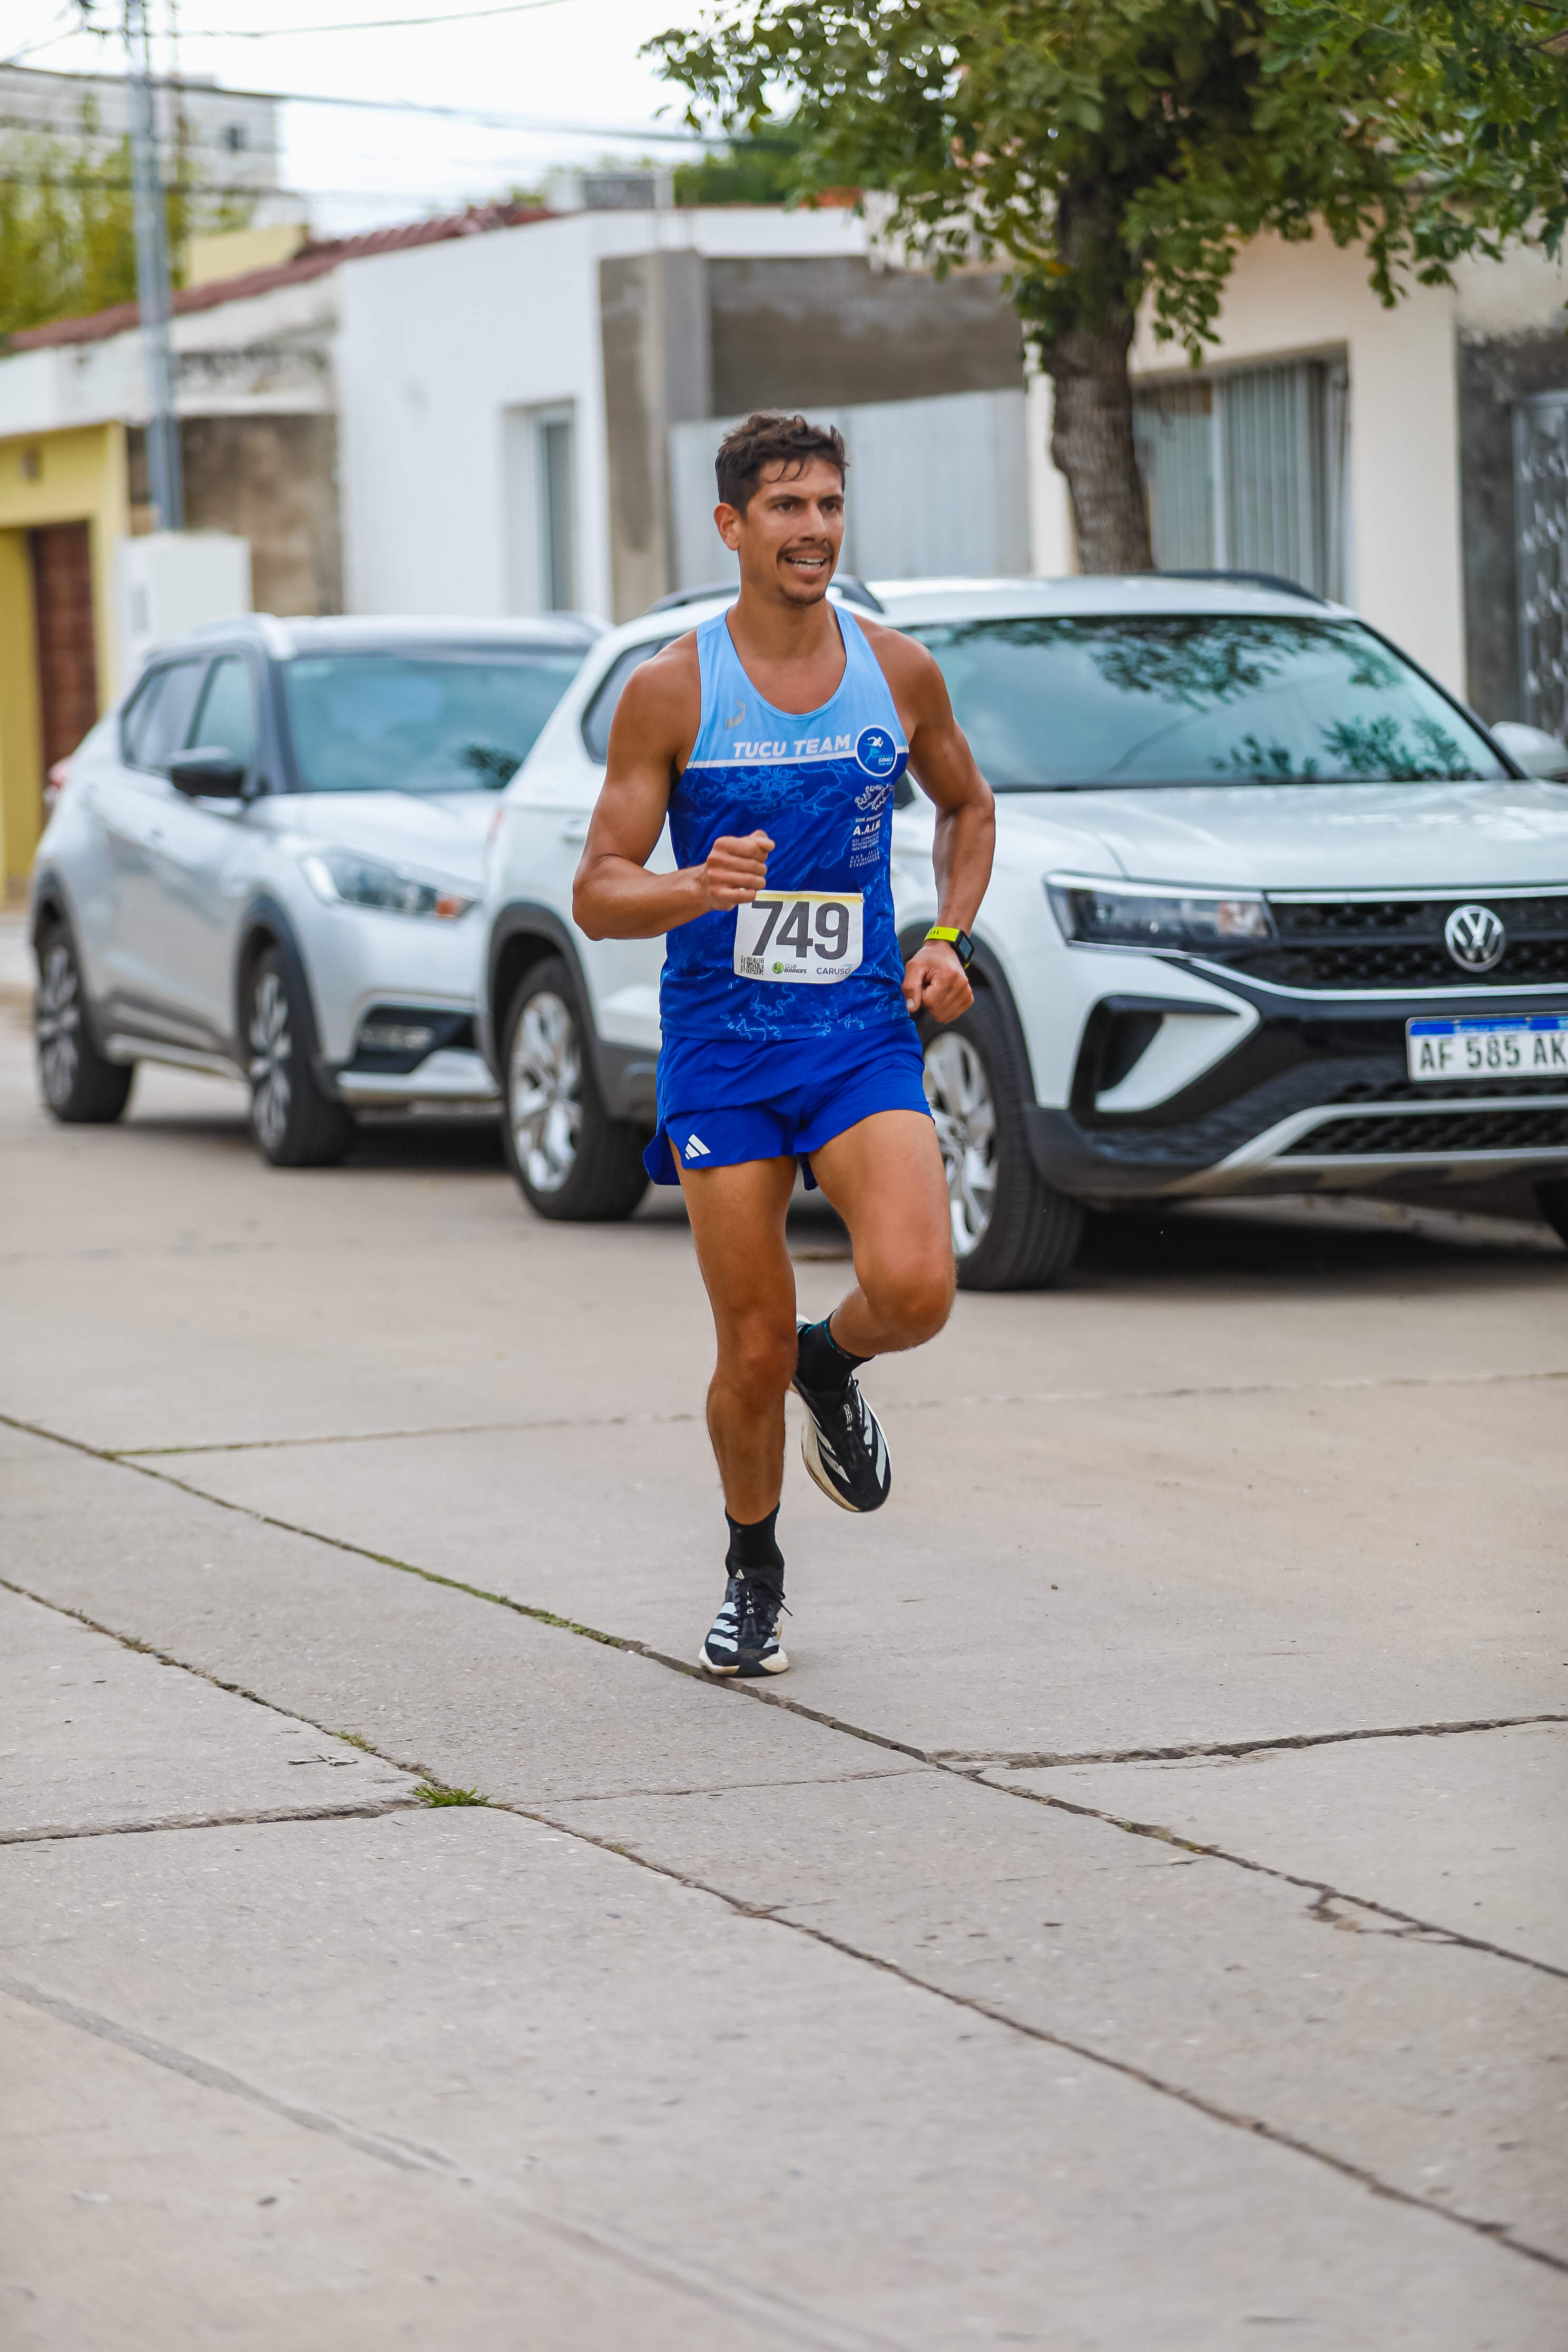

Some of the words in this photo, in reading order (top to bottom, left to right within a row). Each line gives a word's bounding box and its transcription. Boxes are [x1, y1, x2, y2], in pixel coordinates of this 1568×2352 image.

[733, 741, 787, 758] TUCU
[793, 733, 851, 756] TEAM
[751, 900, 849, 960] 749
[1420, 1040, 1454, 1070] AF
[1466, 1035, 1521, 1069] 585
[1534, 1033, 1567, 1065] AK
